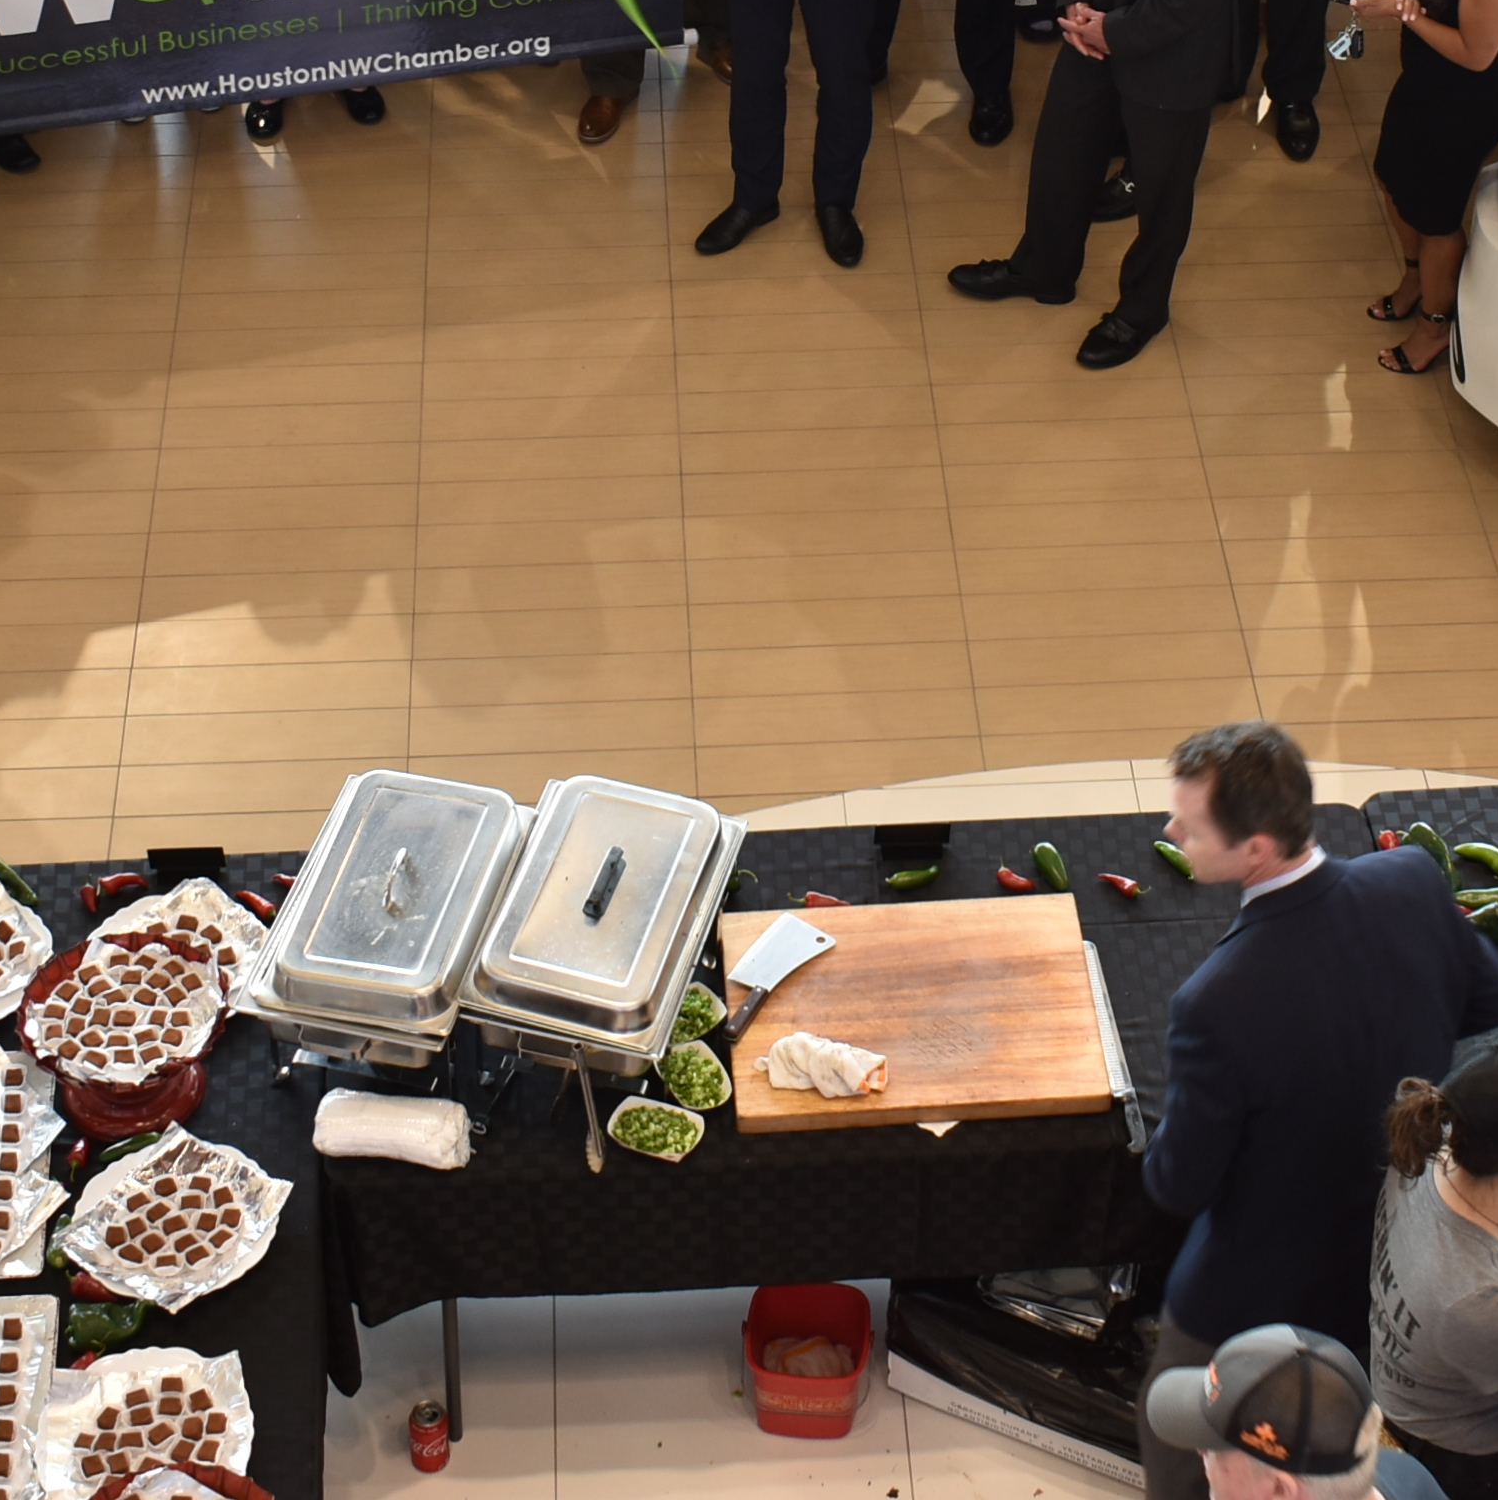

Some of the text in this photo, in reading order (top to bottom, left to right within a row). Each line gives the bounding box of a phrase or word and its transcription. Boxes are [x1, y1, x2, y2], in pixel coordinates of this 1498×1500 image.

[158, 15, 319, 51] Businesses
[141, 36, 551, 104] www.HoustonNWChamber.org
[947, 1406, 961, 1416] NO
[963, 1413, 1020, 1438] ANTIBIOTICS
[1041, 1442, 1055, 1452] NO
[1057, 1450, 1088, 1467] ADDED
[950, 1401, 1140, 1479] CERTIFIED HUMANE VEGETARIAN FED
